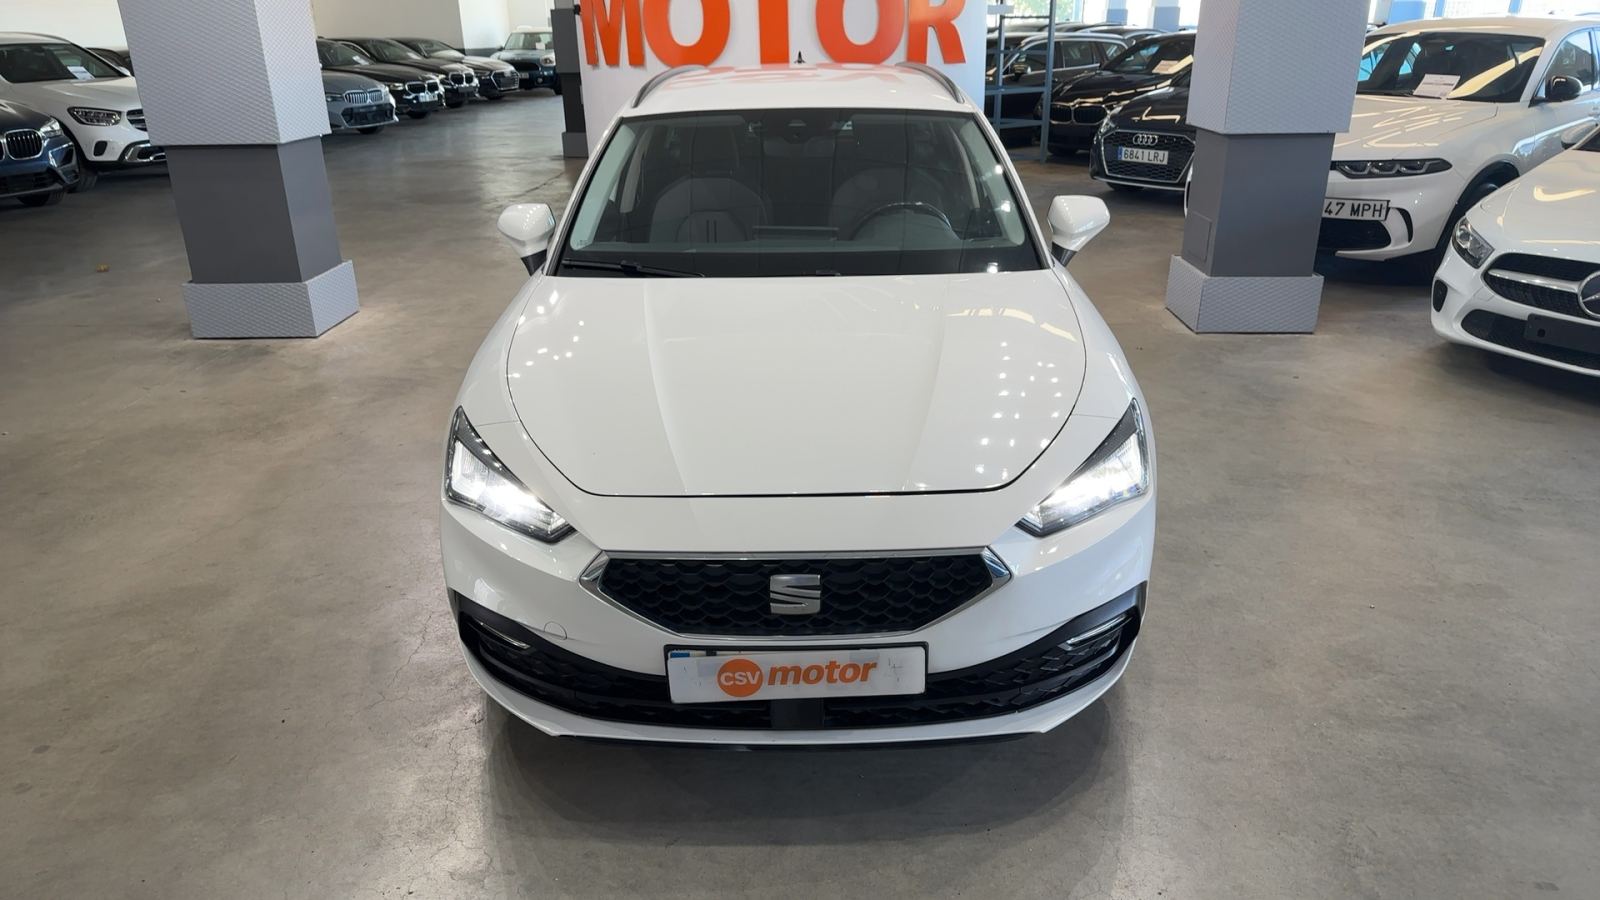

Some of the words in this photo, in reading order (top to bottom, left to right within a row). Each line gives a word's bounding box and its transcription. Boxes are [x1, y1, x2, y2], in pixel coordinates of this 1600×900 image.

[1123, 148, 1145, 161] 6841
[1147, 151, 1166, 163] LRJ
[1349, 202, 1384, 218] MPH
[767, 660, 878, 686] motor
